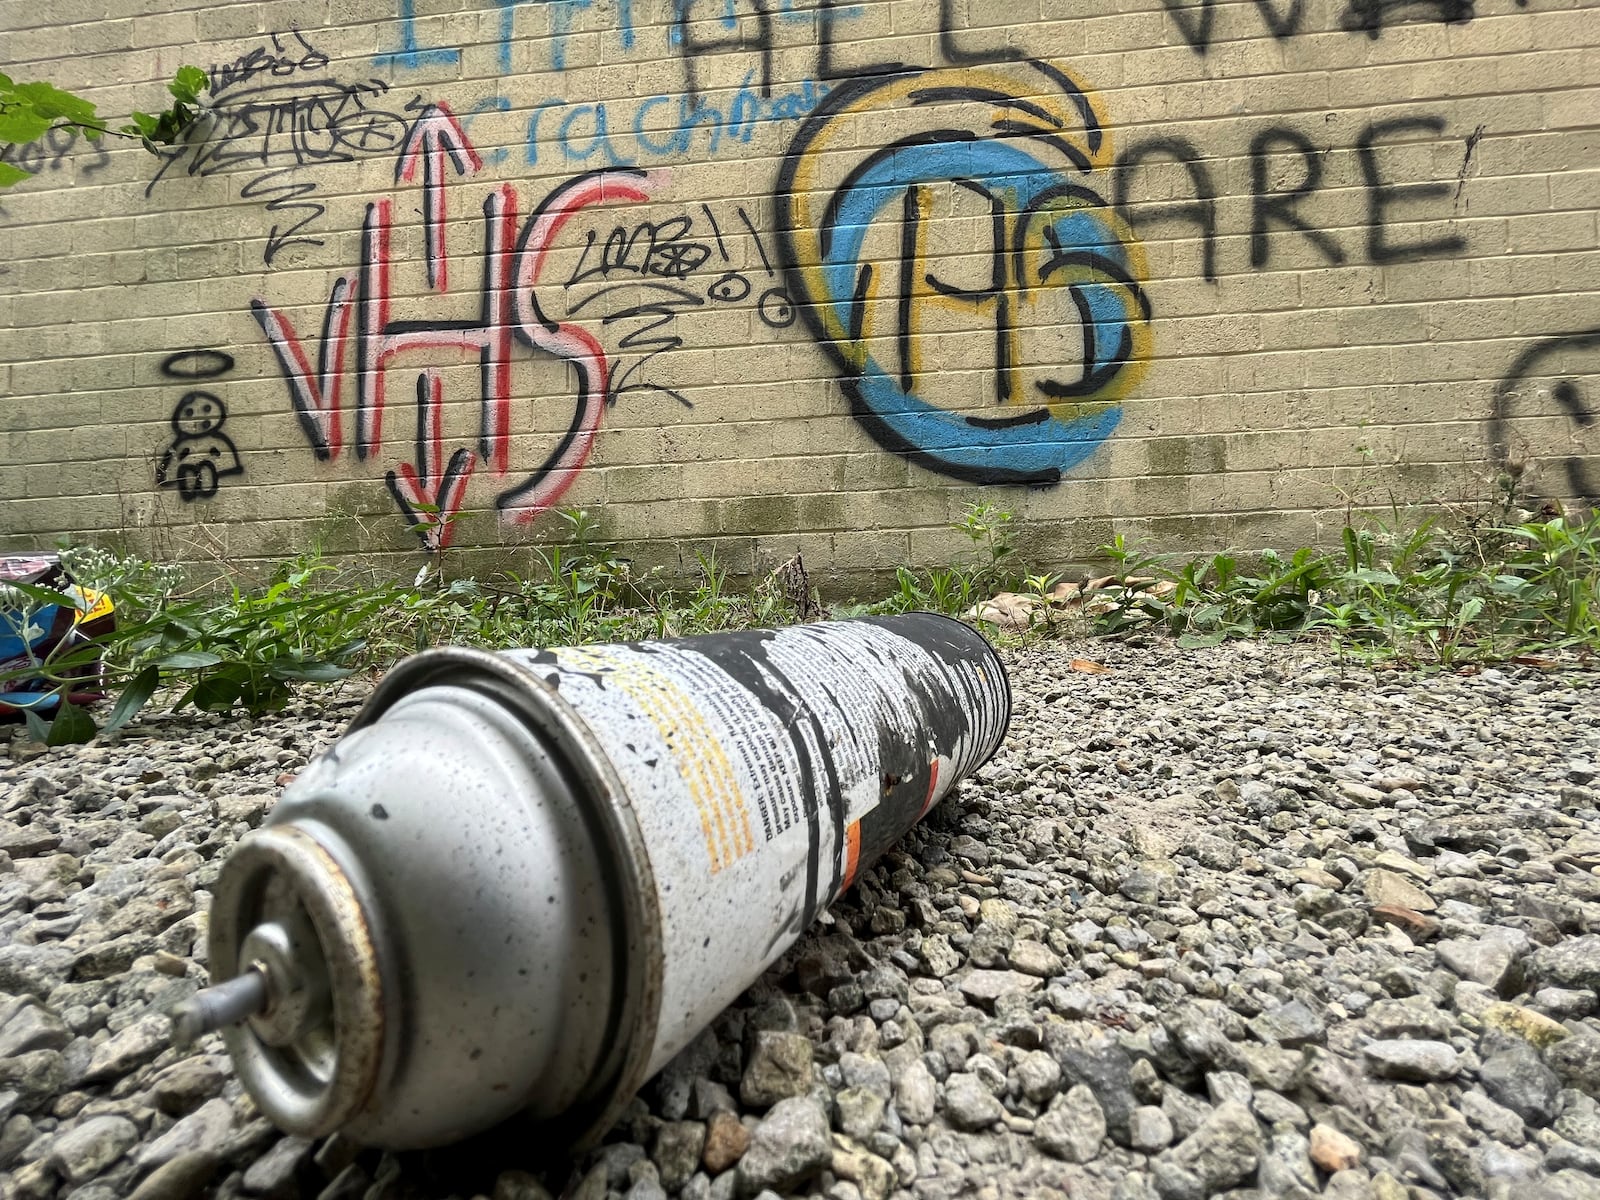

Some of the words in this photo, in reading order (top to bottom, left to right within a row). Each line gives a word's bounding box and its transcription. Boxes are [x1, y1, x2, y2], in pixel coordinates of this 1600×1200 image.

[1114, 115, 1468, 283] ARE
[250, 163, 660, 526] VHS
[701, 691, 738, 738] flammable
[734, 690, 760, 720] REACH
[736, 723, 762, 762] explode
[754, 732, 777, 773] damage
[762, 730, 778, 750] OUT
[735, 740, 761, 790] Extremely
[757, 762, 771, 785] may
[773, 750, 788, 776] KEEP
[771, 773, 786, 805] cause
[757, 792, 774, 842] DANGER:
[779, 805, 793, 830] May
